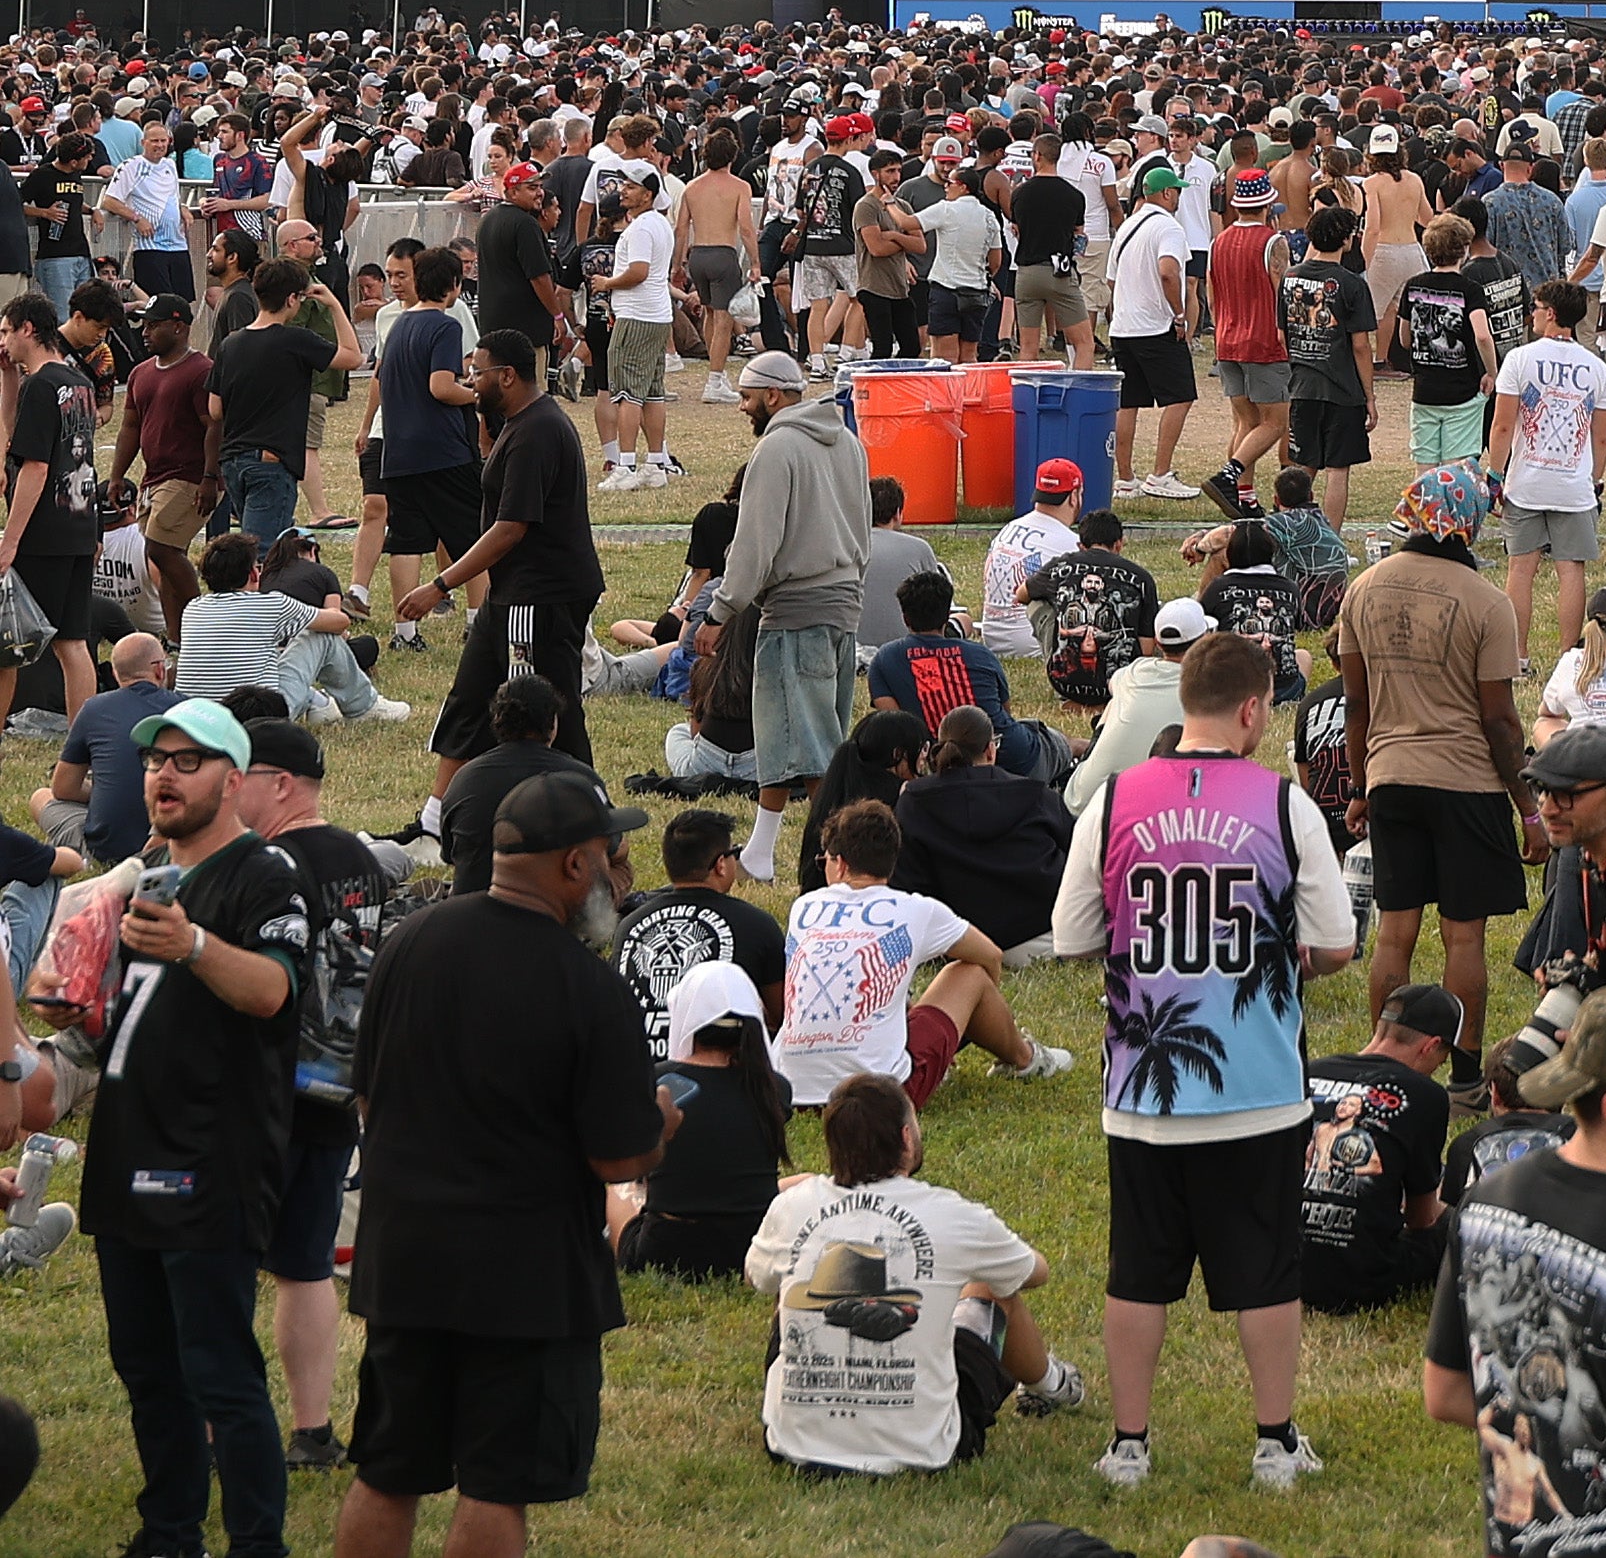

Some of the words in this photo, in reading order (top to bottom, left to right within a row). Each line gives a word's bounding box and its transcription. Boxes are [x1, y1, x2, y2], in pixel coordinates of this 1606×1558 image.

[1033, 16, 1075, 28] MONSTER
[56, 182, 76, 194] UFC
[1536, 360, 1591, 392] UFC
[1545, 385, 1583, 402] Freedom
[1551, 399, 1569, 413] 250
[93, 576, 114, 589] 250
[907, 646, 962, 659] FREEDOM
[1132, 807, 1255, 855] O'MALLEY
[629, 904, 697, 938] FIGHTING
[797, 899, 897, 930] UFC
[1127, 862, 1257, 979] 305
[801, 928, 877, 944] Freedom
[812, 940, 848, 958] 250
[106, 961, 167, 1080] 7
[837, 1024, 872, 1043] DC
[885, 1204, 934, 1280] ANYWHERE
[846, 1370, 916, 1393] CHAMPIONSHIP
